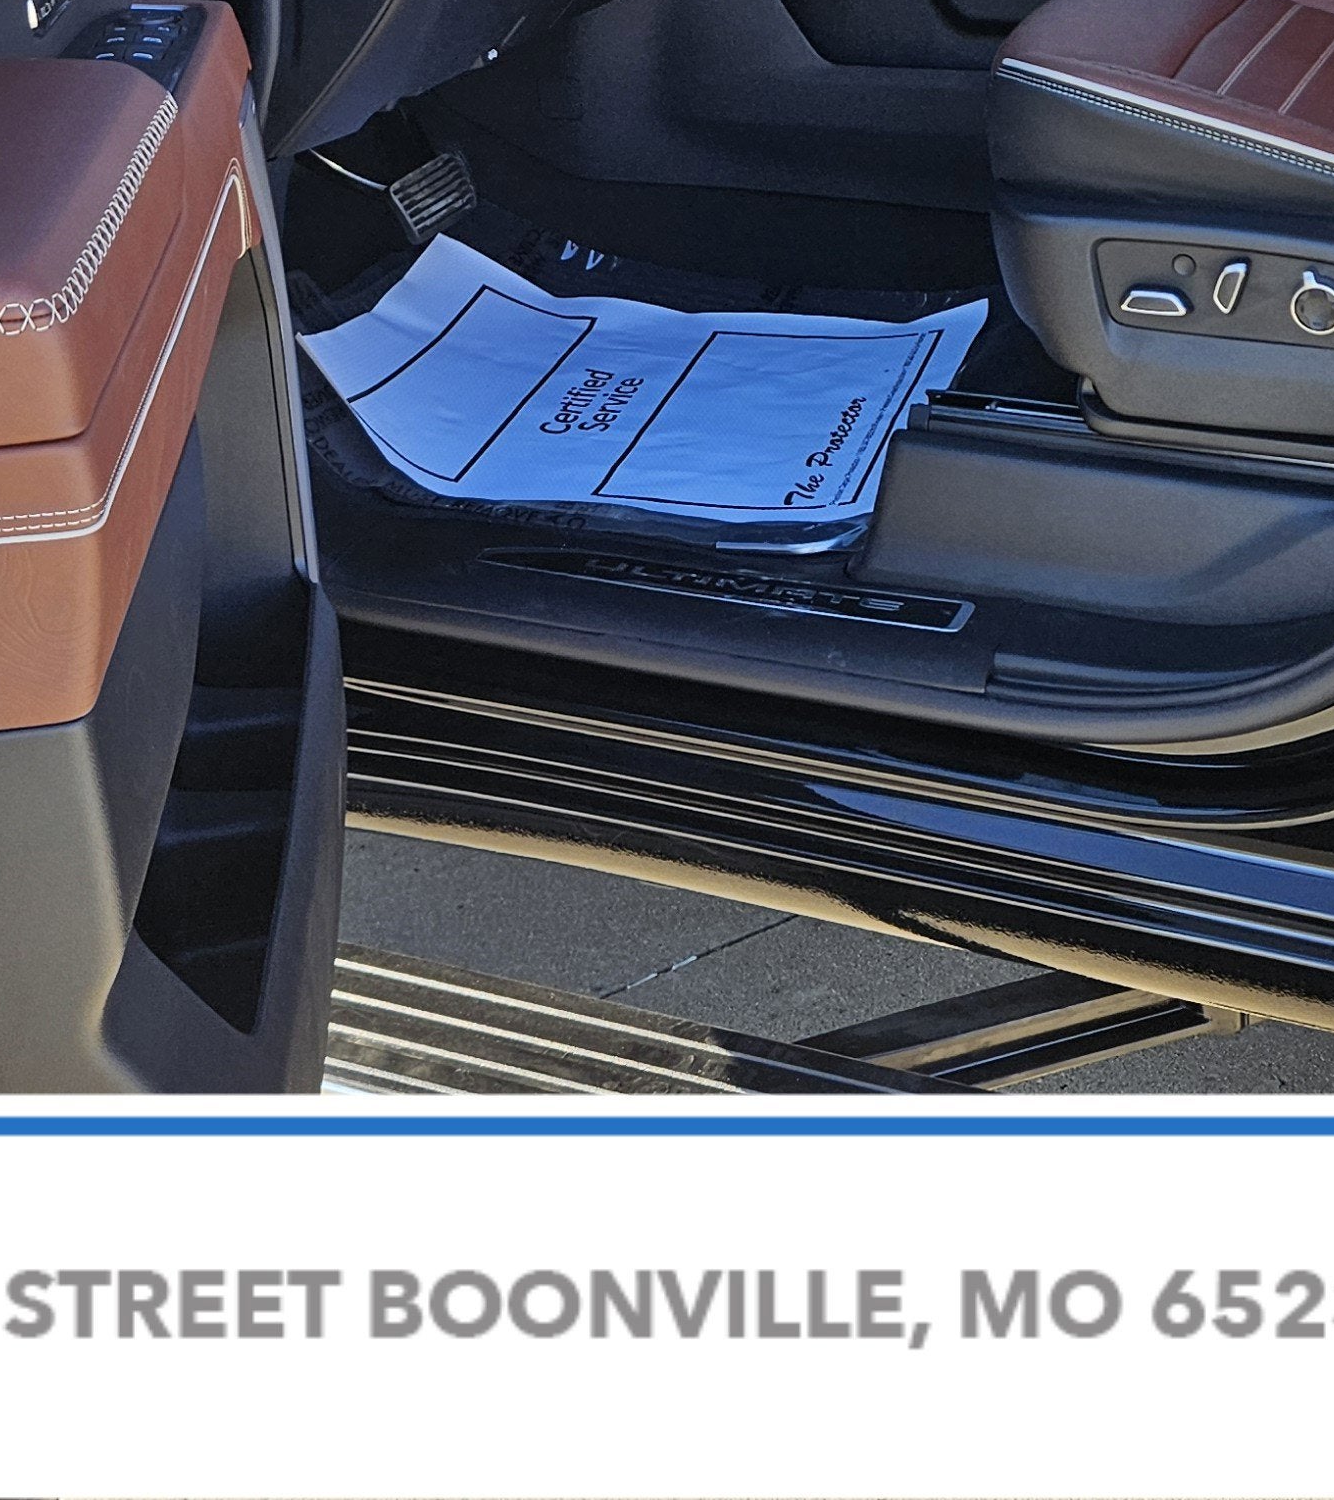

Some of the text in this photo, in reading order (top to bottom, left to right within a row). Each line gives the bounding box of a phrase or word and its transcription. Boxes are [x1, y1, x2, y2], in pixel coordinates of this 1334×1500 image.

[539, 368, 615, 436] Certified
[577, 376, 645, 434] Service
[784, 465, 826, 508] The
[805, 395, 867, 474] Protector
[584, 558, 905, 612] ULTIMATE
